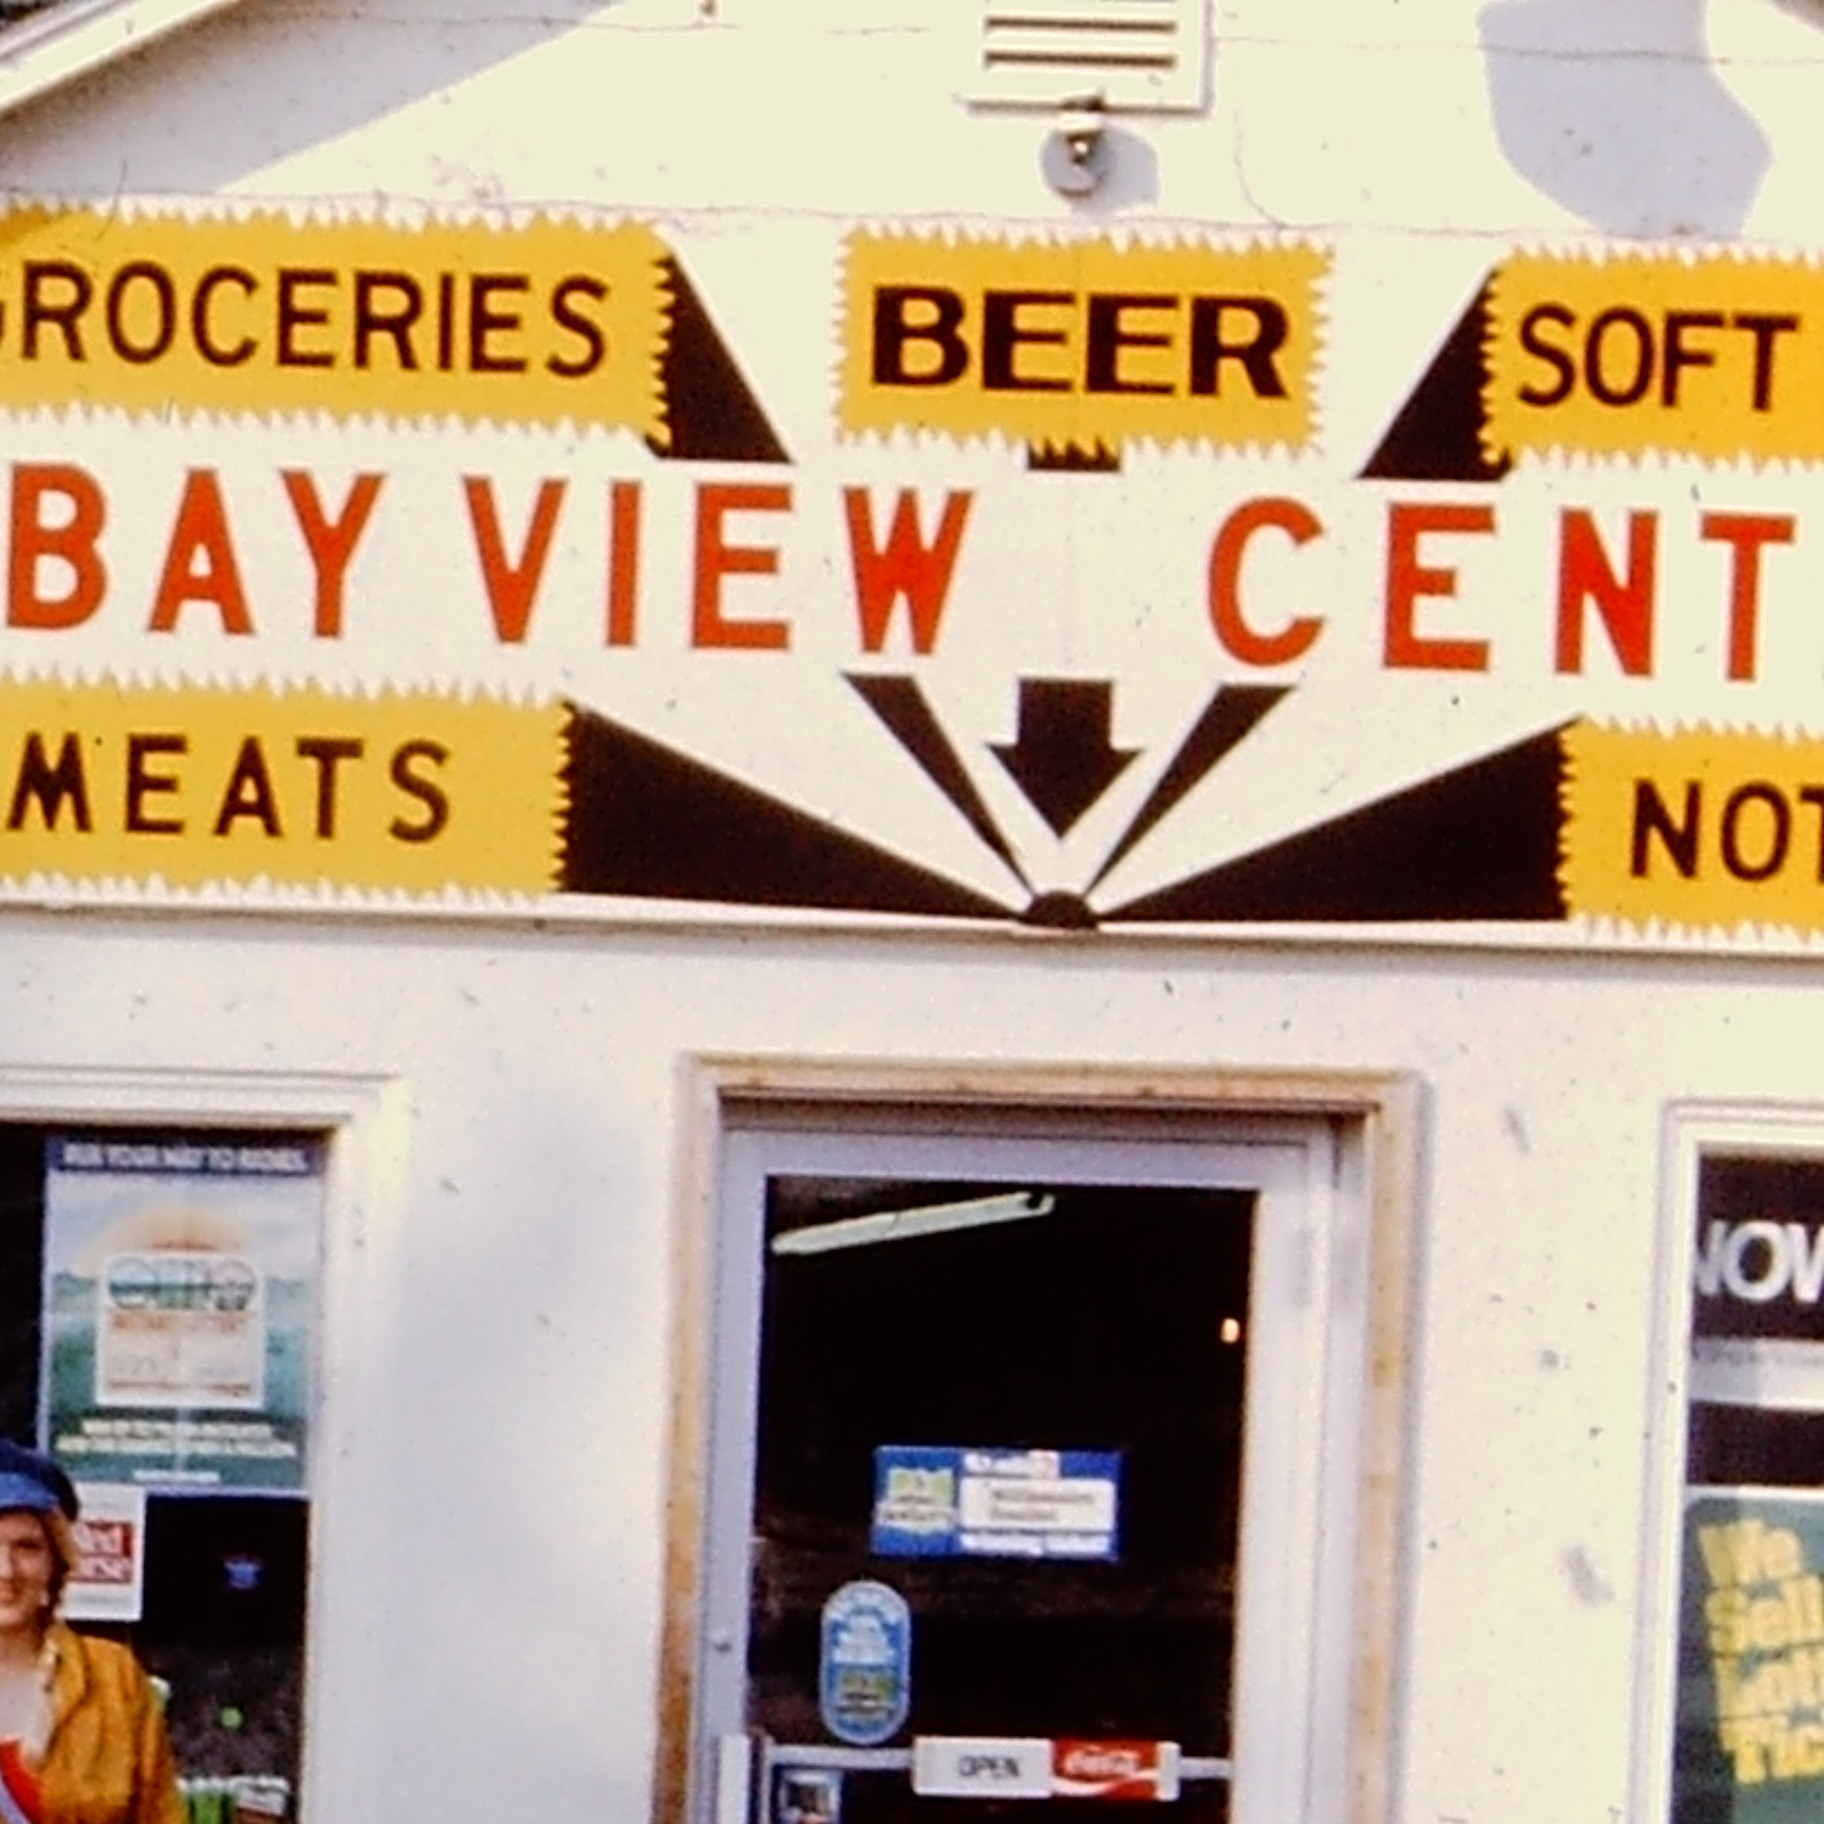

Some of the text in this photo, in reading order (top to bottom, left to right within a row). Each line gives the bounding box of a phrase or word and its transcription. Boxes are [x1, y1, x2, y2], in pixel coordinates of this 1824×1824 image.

[870, 284, 1290, 399] BEER
[1517, 304, 1800, 411] SOFT
[1206, 495, 1797, 683] CENT
[4, 731, 451, 844] MEATS
